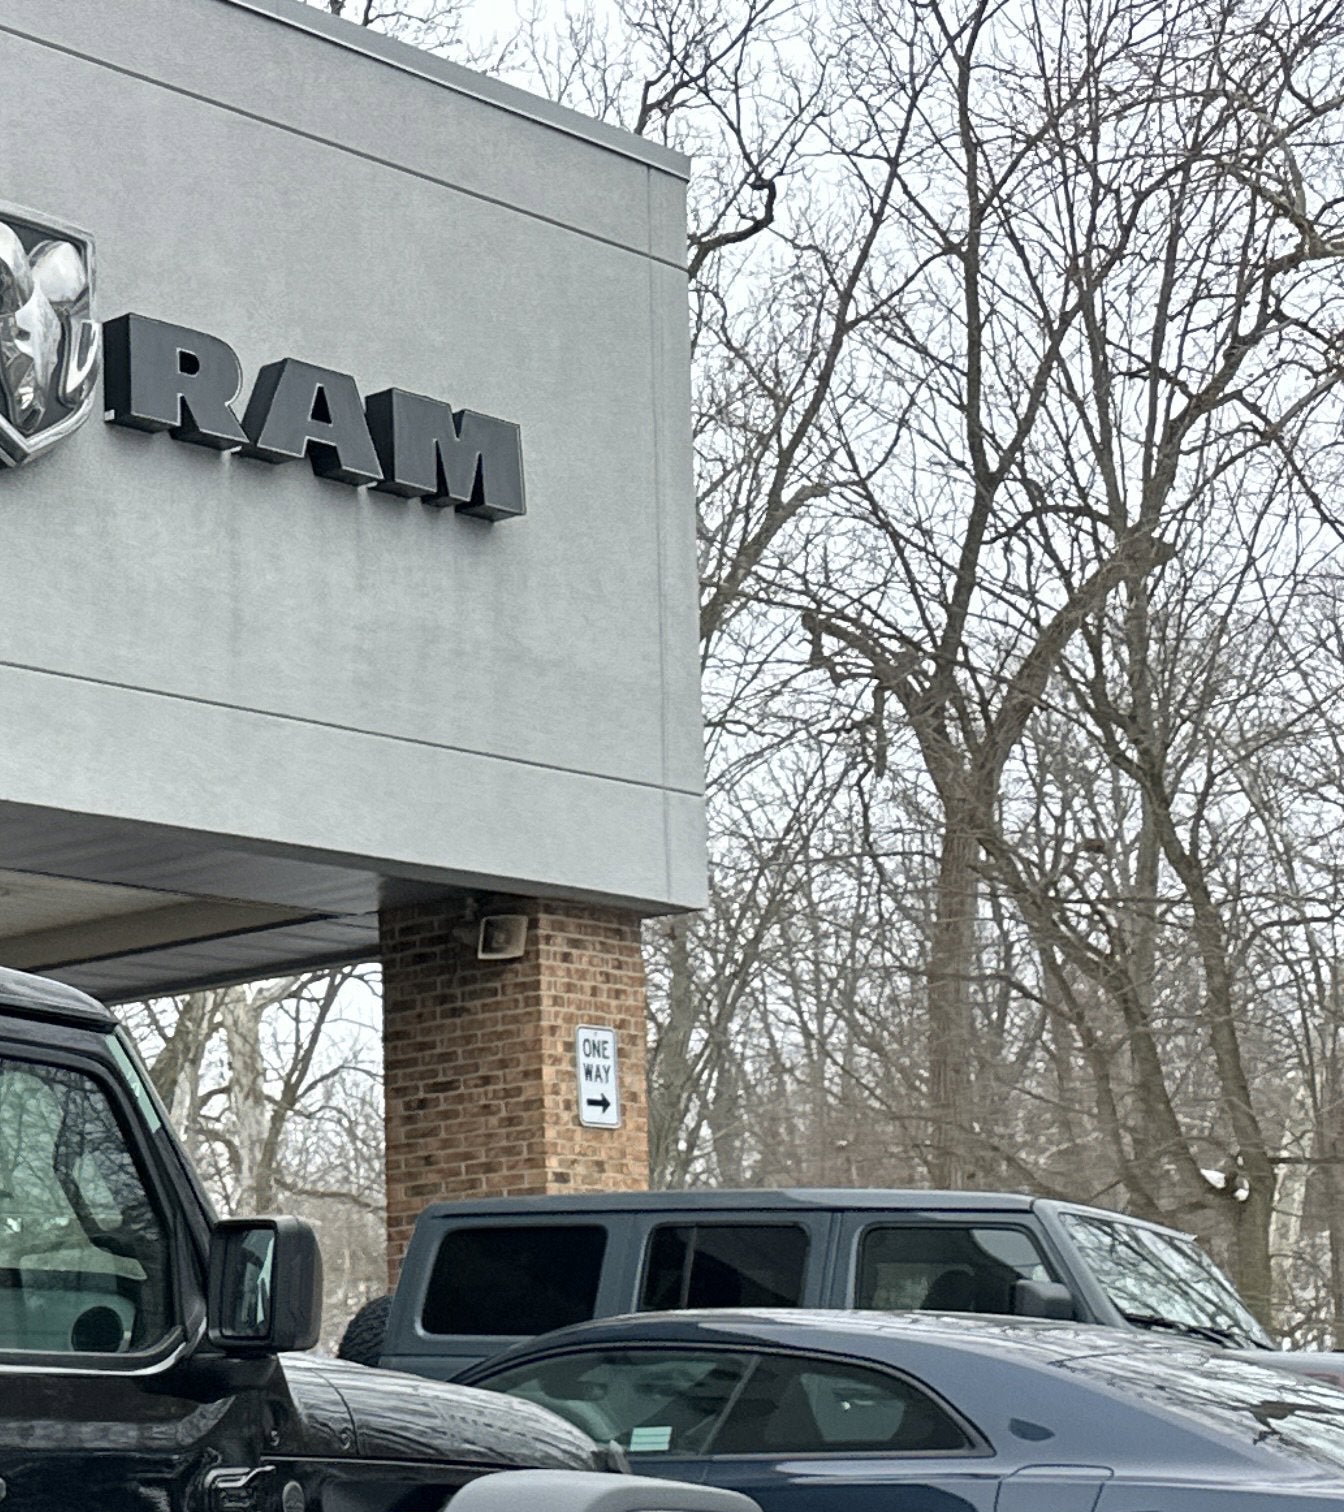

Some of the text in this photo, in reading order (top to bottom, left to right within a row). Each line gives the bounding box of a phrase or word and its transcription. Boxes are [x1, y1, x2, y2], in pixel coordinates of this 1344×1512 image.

[103, 313, 526, 522] RAM
[582, 1038, 610, 1059] ONE
[584, 1063, 611, 1084] WAY
